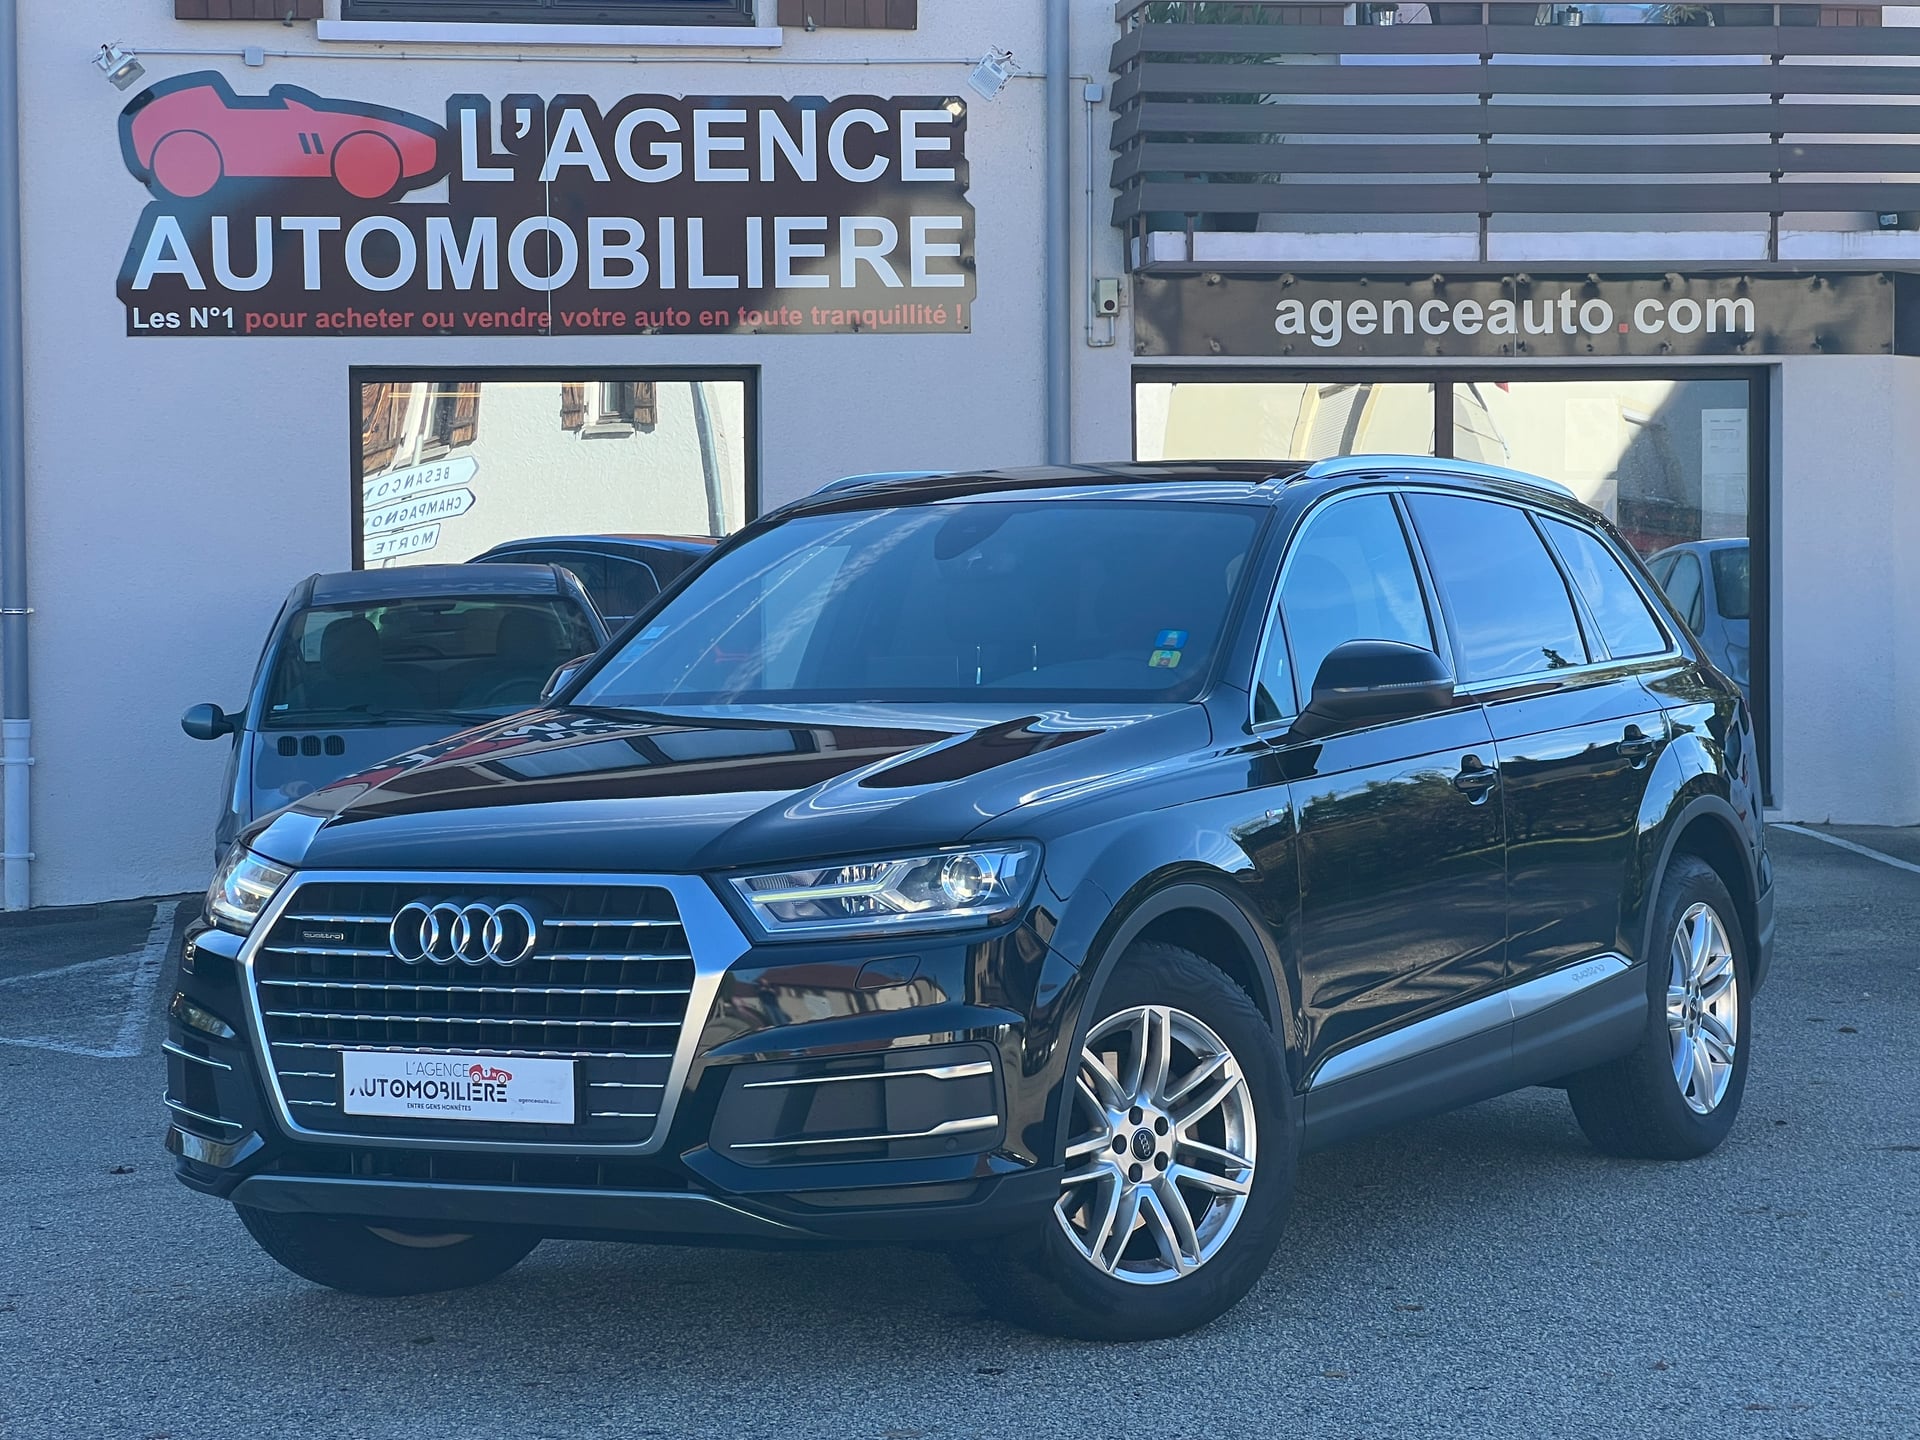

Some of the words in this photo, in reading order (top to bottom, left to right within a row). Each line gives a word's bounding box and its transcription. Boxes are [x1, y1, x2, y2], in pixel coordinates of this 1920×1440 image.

[460, 107, 956, 184] L'AGENCE
[130, 214, 965, 292] AUTOMOBILIERE
[132, 307, 180, 329] Les
[189, 306, 234, 329] N°1
[244, 312, 306, 333] pour
[314, 307, 414, 329] acheter
[421, 312, 455, 329] ou
[463, 307, 552, 329] vendre
[560, 307, 627, 328] votre
[634, 307, 691, 328] auto
[698, 311, 730, 327] en
[737, 307, 803, 327] toute
[810, 303, 947, 331] tranquillité
[954, 303, 962, 325] !
[1274, 288, 1755, 348] agenceauto.com
[405, 1061, 469, 1077] L'AGENCE
[407, 1102, 424, 1110] ENTRE
